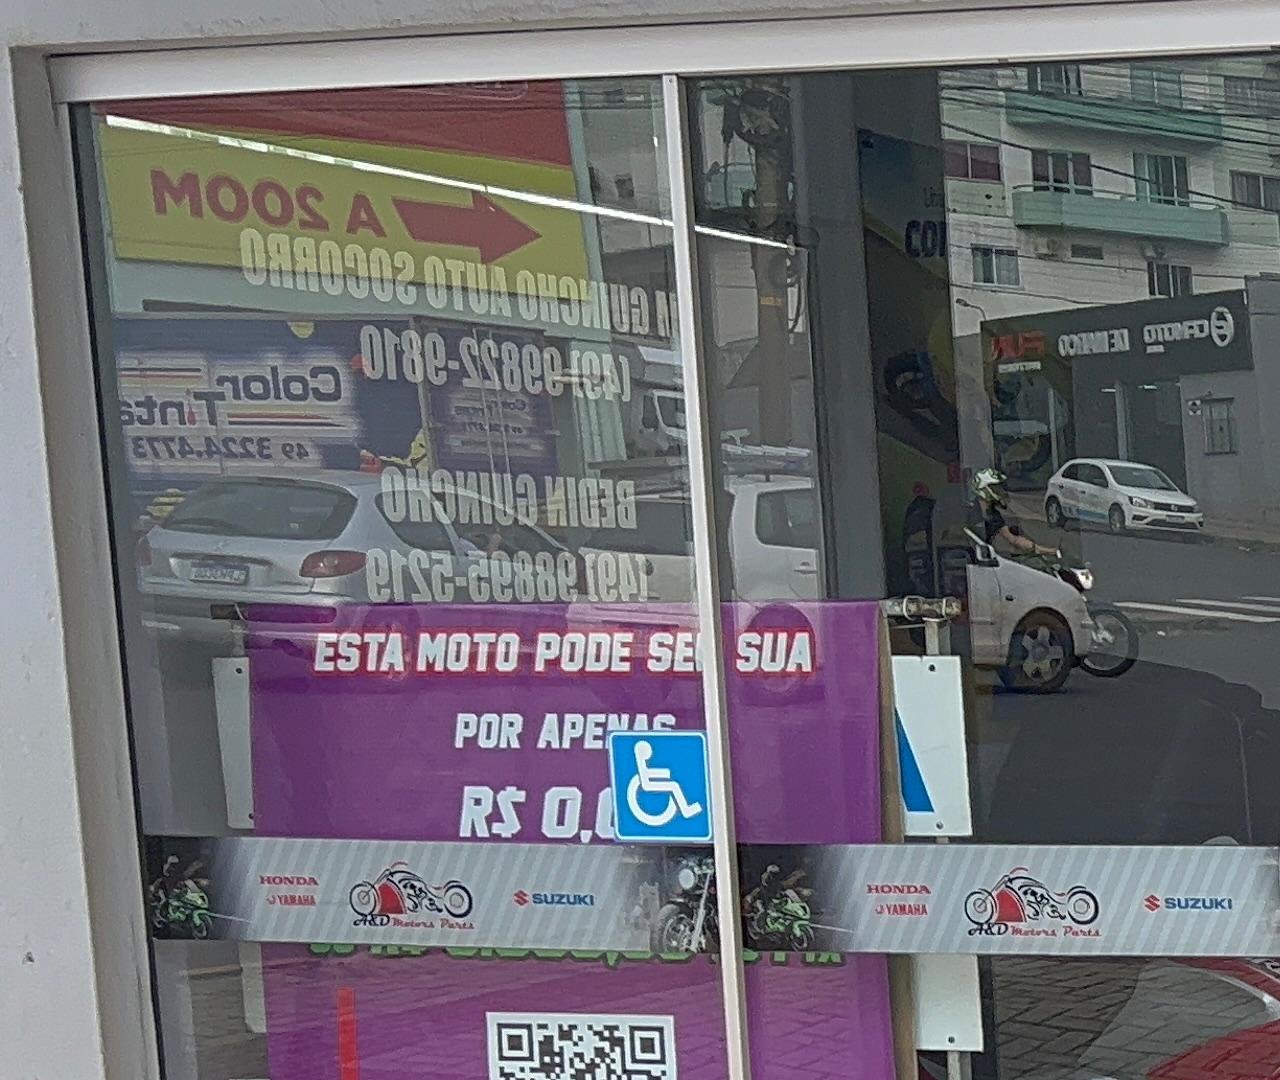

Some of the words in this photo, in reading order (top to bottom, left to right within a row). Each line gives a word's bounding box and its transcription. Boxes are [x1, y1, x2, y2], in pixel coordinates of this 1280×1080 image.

[313, 632, 401, 673] ESTA
[416, 633, 518, 673] MOTO
[534, 634, 631, 673] PODE
[735, 634, 814, 673] SUA
[455, 713, 523, 749] POR
[459, 786, 527, 838] R$
[259, 875, 319, 887] HONDA
[867, 884, 932, 896] HONDA
[278, 895, 316, 907] YAMAHA
[532, 892, 595, 908] SUZUKI
[1165, 896, 1233, 911] SUZUKI
[886, 904, 929, 916] YAMAHA
[353, 914, 391, 928] A&D
[392, 918, 437, 930] Motors
[440, 919, 475, 931] Parts
[968, 924, 1009, 938] A&D
[1011, 926, 1058, 938] Motors
[1063, 926, 1101, 938] Parts
